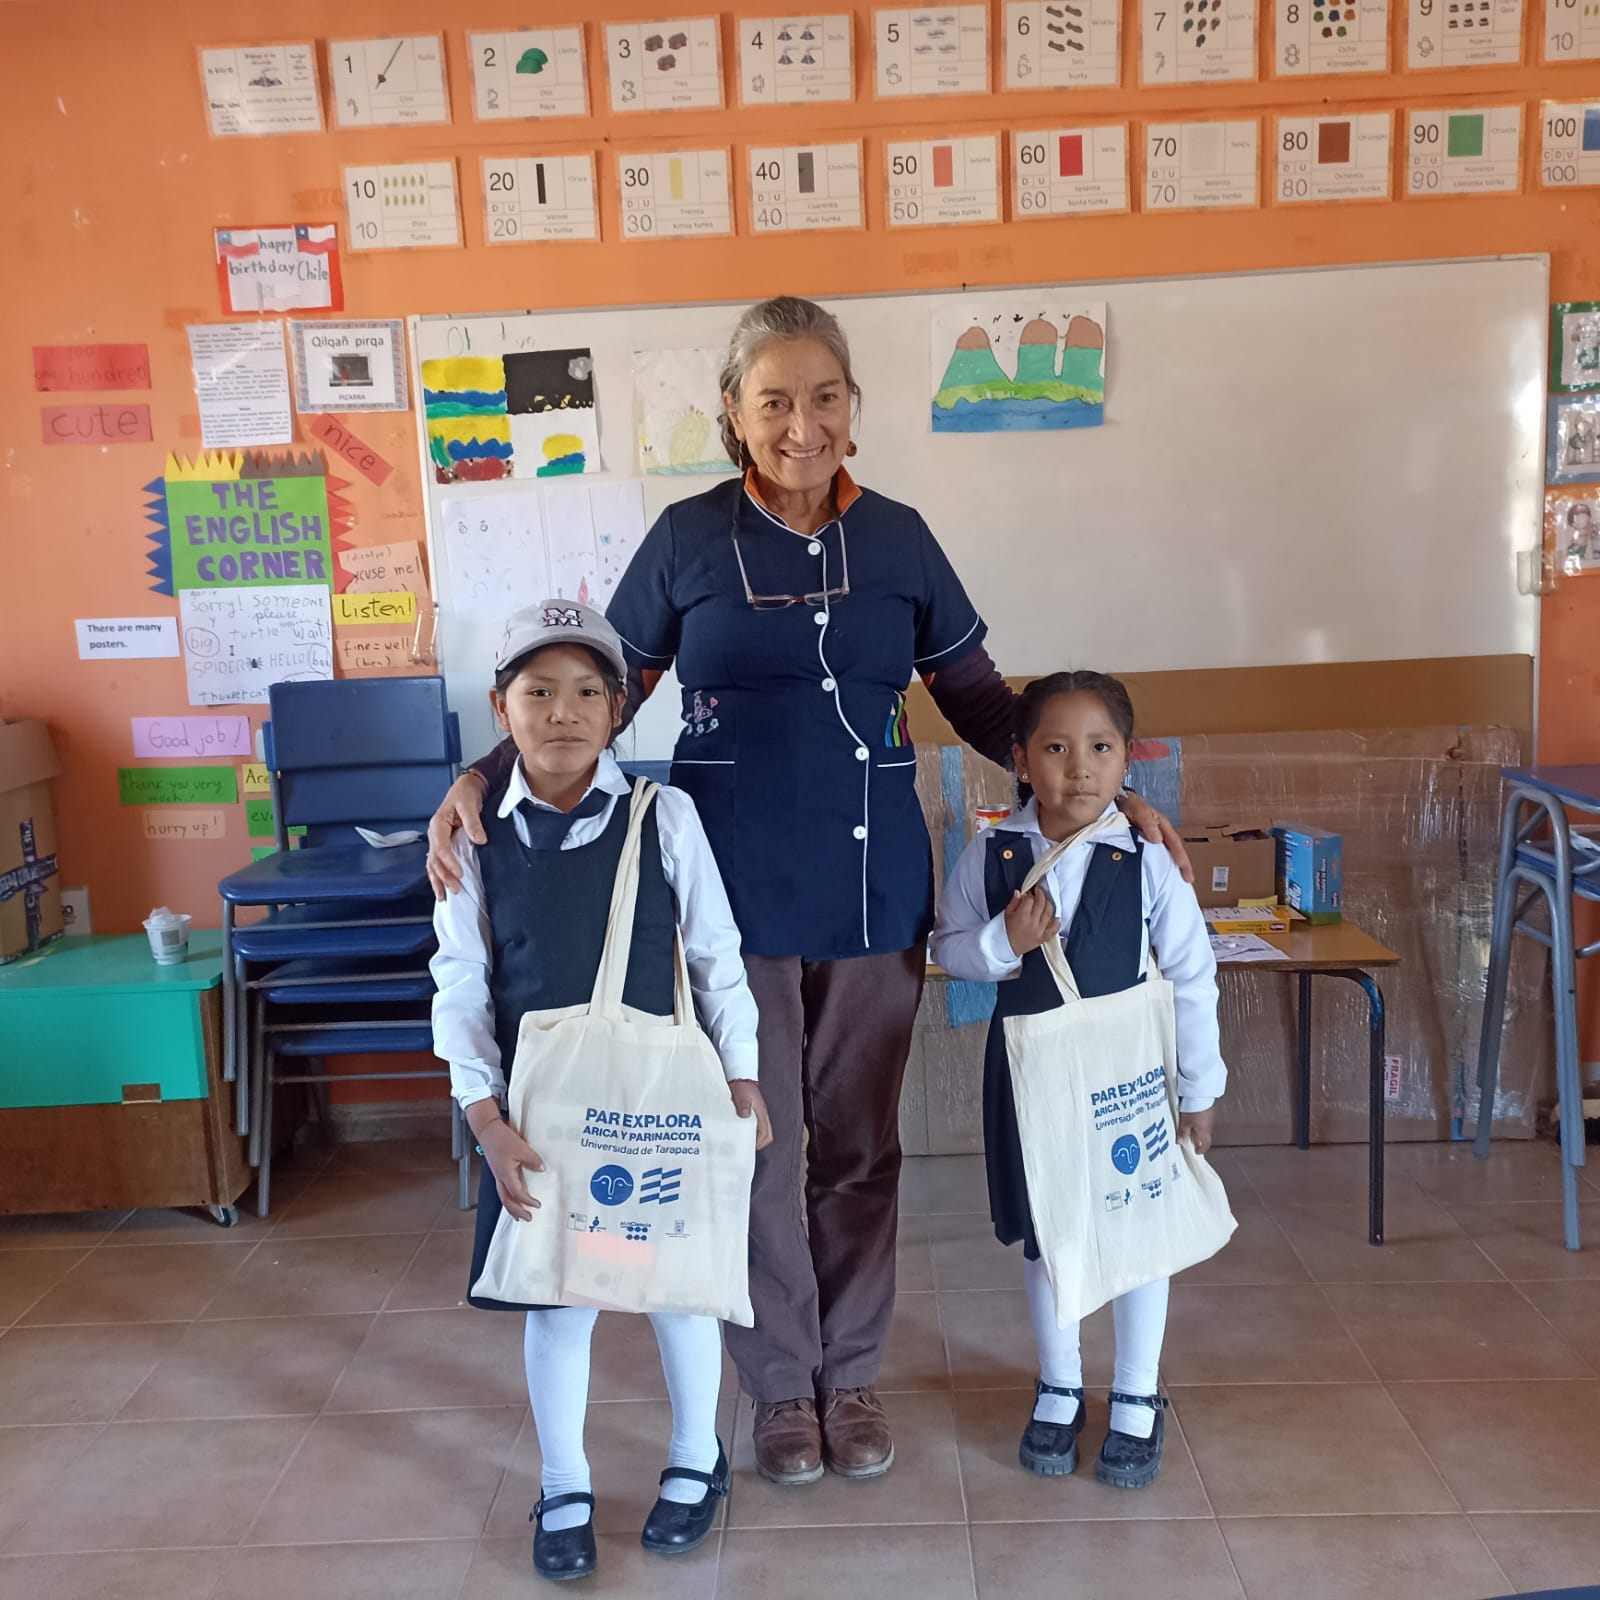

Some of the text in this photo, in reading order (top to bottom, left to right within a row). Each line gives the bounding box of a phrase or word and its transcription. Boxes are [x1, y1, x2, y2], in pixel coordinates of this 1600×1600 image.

[1154, 12, 1166, 32] 7
[1287, 4, 1300, 24] 8
[887, 23, 900, 43] 5
[1017, 16, 1030, 36] 6
[618, 39, 631, 58] 3
[751, 31, 764, 50] 4
[1551, 32, 1574, 51] 10
[344, 55, 352, 73] 1
[483, 47, 496, 67] 2
[1414, 124, 1439, 144] 90
[1547, 118, 1576, 138] 100
[1152, 137, 1177, 157] 70
[1283, 131, 1308, 151] 80
[1020, 145, 1045, 164] 60
[756, 161, 780, 181] 40
[892, 155, 918, 175] 50
[1543, 165, 1576, 182] 100
[489, 172, 514, 191] 20
[624, 167, 649, 187] 30
[1412, 170, 1439, 190] 90
[352, 179, 376, 199] 10
[1152, 184, 1176, 204] 70
[1282, 179, 1308, 198] 80
[1021, 190, 1047, 210] 60
[758, 208, 782, 226] 40
[893, 201, 918, 220] 50
[356, 221, 378, 240] 10
[493, 218, 517, 237] 20
[627, 214, 652, 233] 30
[257, 232, 293, 254] happy
[228, 260, 329, 281] birthday Chile
[311, 335, 384, 349] Qilqañ pirqa
[51, 407, 138, 437] cute
[324, 422, 376, 471] nice
[211, 480, 279, 510] THE
[185, 512, 322, 545] ENGLISH
[197, 550, 327, 582] CORNER
[353, 566, 386, 584] xcuse
[87, 624, 162, 633] There are many
[89, 640, 128, 651] posters.
[190, 632, 213, 651] big
[344, 640, 370, 657] fine
[384, 637, 409, 650] well
[192, 659, 246, 678] SPIDER
[149, 722, 190, 749] Good
[194, 779, 223, 794] very
[1091, 1086, 1117, 1106] PAR
[585, 1108, 702, 1129] PAR EXPLORA
[1094, 1102, 1120, 1118] ARICA
[1121, 1100, 1127, 1109] Y
[583, 1126, 701, 1142] ARICA Y PARINACOTA
[581, 1138, 639, 1155] Universidad
[641, 1146, 653, 1155] de
